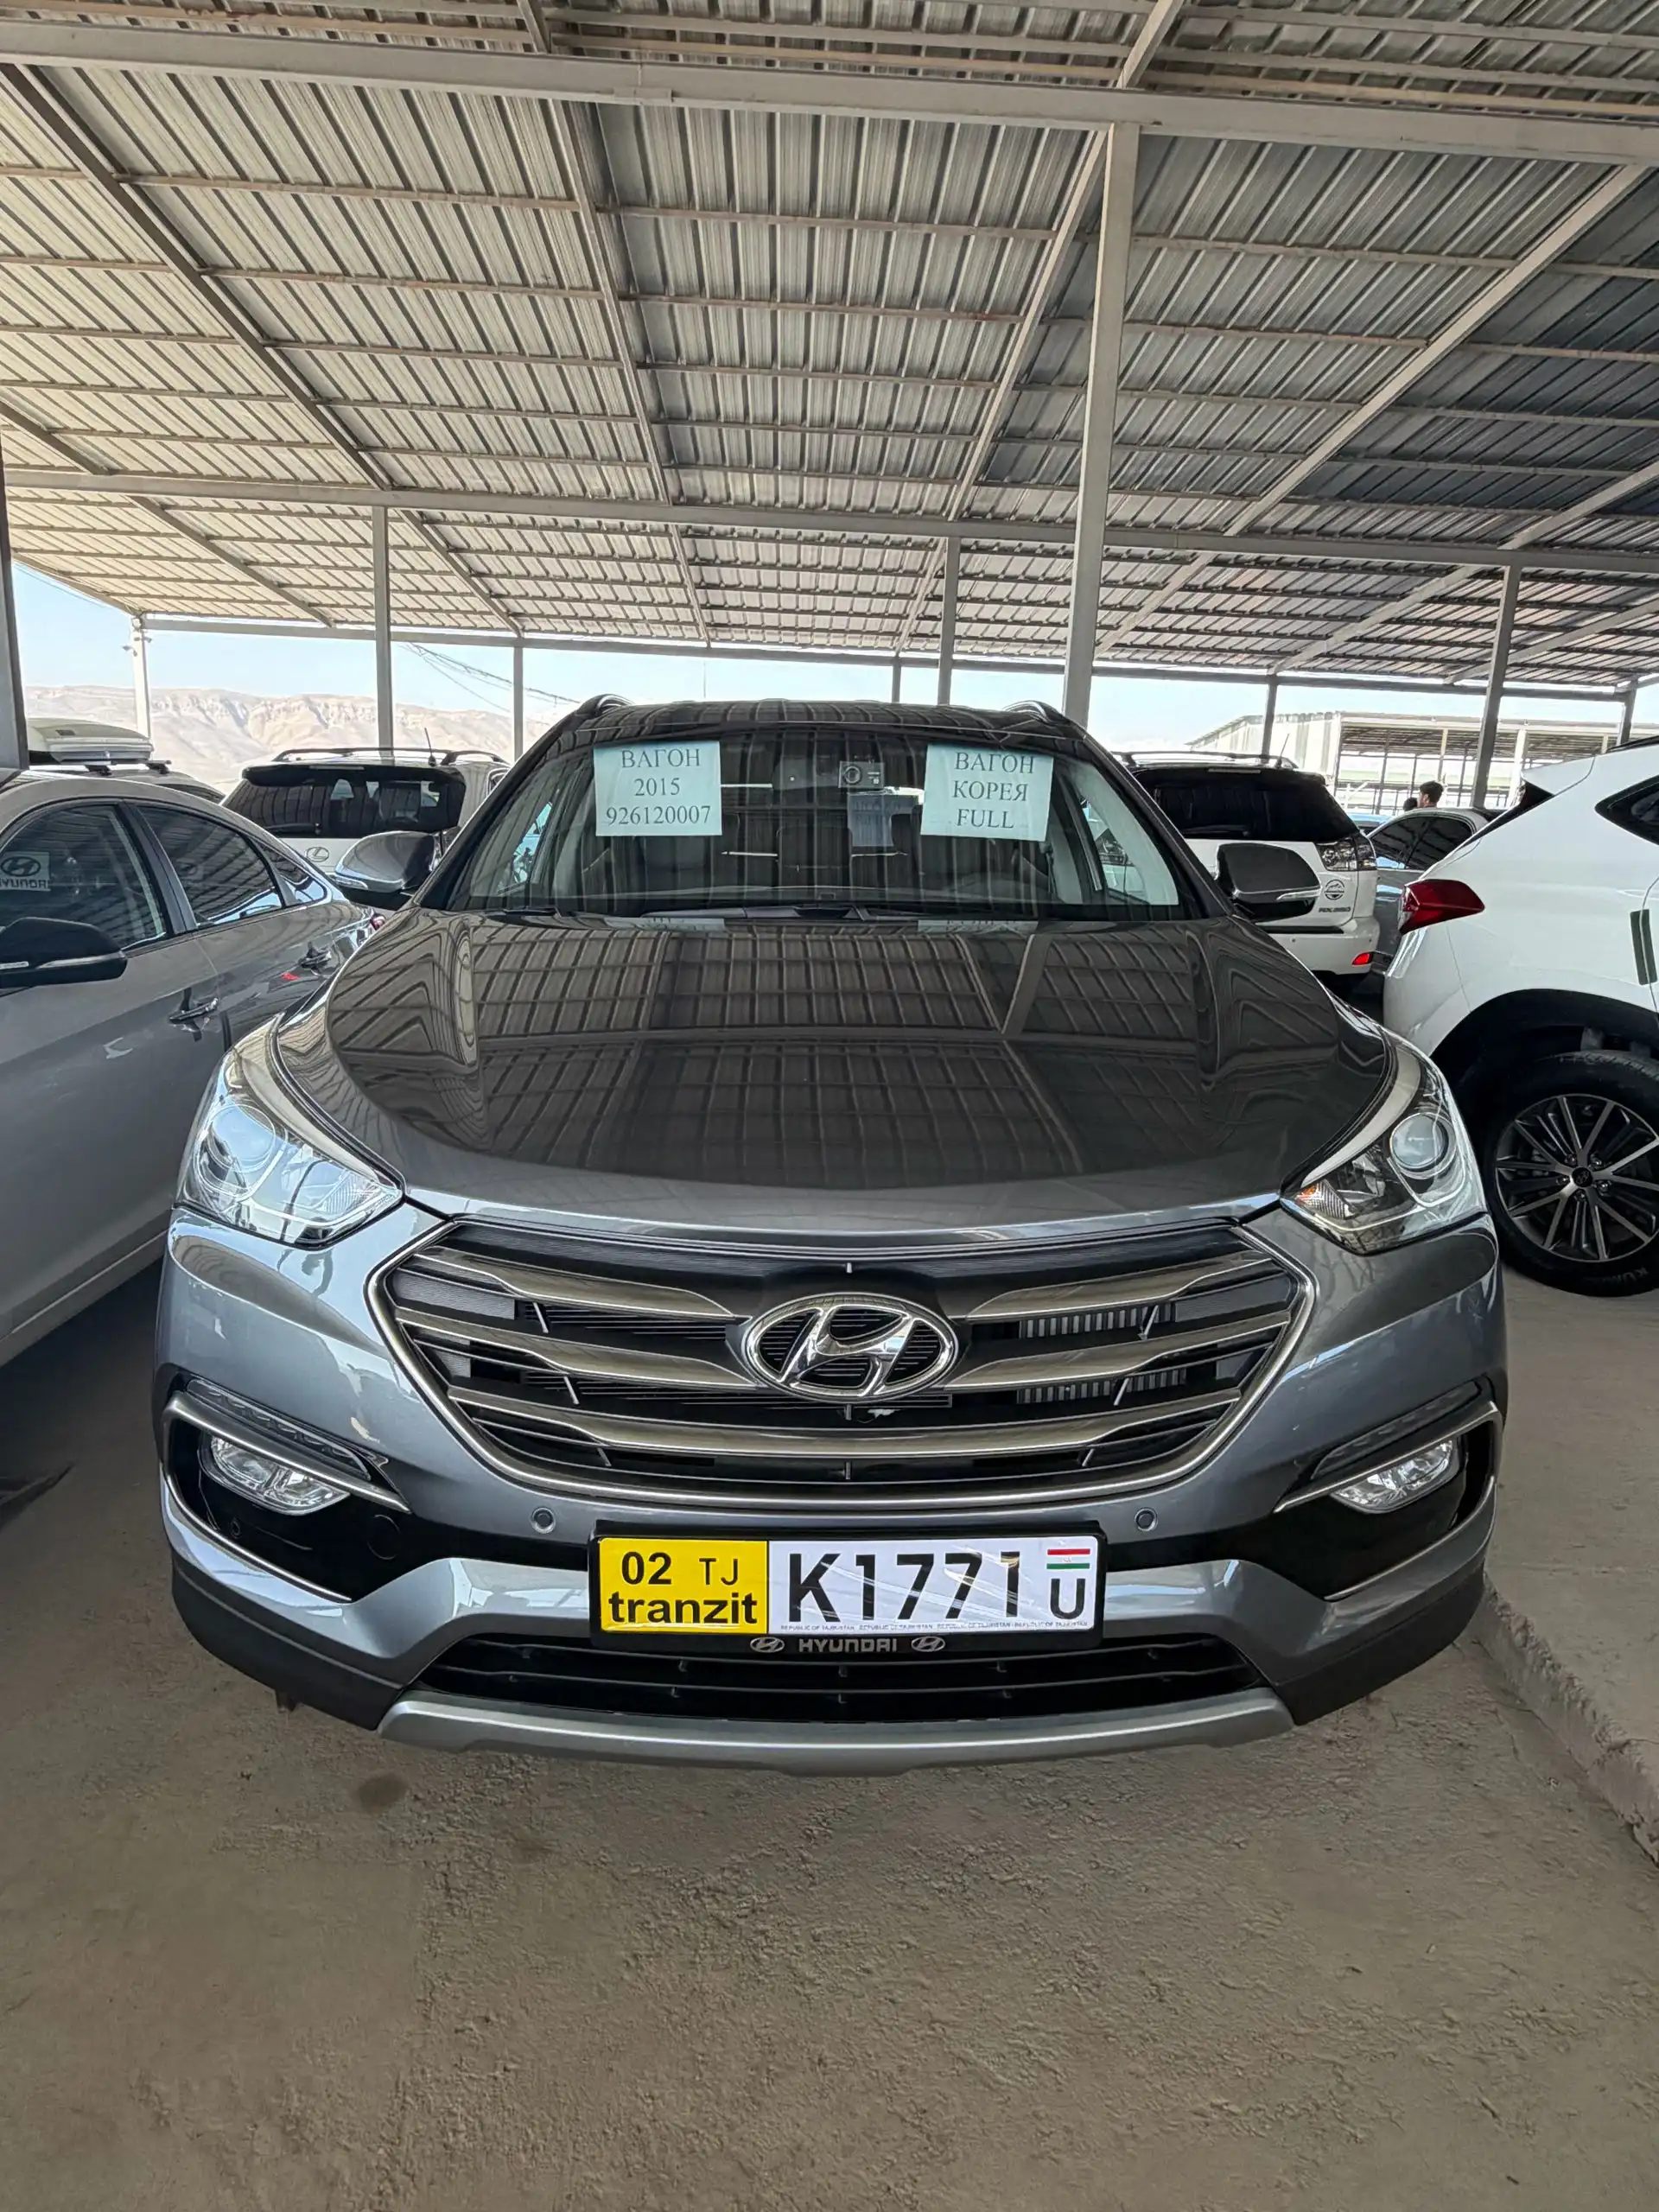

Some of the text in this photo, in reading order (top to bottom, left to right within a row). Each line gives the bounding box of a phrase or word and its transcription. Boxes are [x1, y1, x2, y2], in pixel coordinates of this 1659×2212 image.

[621, 748, 700, 768] ВАГОН
[954, 752, 1034, 774] ВАГОН
[633, 777, 681, 796] 2015
[952, 780, 1028, 801] КОРЕЯ
[606, 805, 711, 826] 926120007
[957, 808, 1014, 829] FULL
[0, 878, 50, 889] YUNDAI
[621, 1551, 738, 1586] 02 TJ
[788, 1550, 1086, 1622] K1771 U
[608, 1591, 757, 1624] tranzit
[798, 1638, 897, 1653] HYUNDAI
